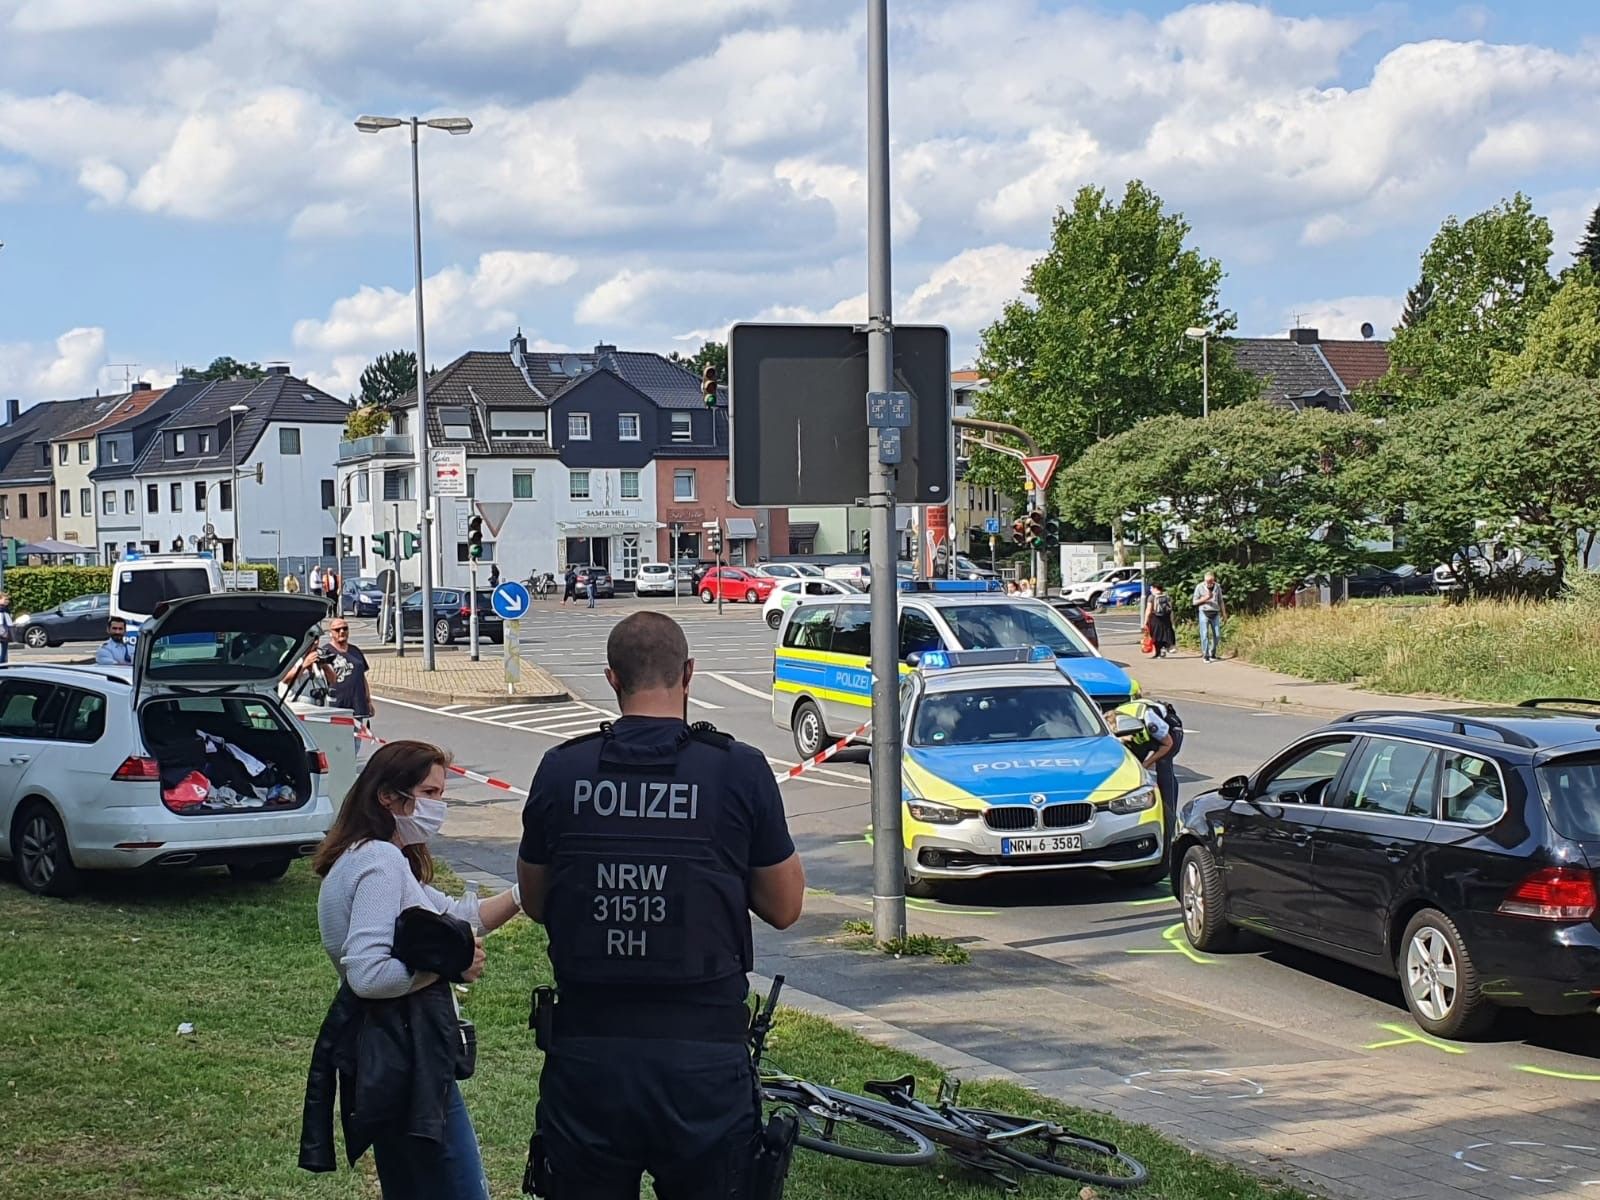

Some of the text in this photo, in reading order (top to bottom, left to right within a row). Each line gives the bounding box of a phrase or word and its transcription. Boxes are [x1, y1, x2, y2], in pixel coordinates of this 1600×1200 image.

[836, 671, 870, 689] POLIZEI
[972, 758, 1083, 773] POLIZEI
[573, 779, 699, 820] POLIZEI
[1009, 839, 1032, 853] NRW
[596, 863, 668, 891] NRW
[593, 894, 667, 922] 31513
[606, 928, 647, 957] RH
